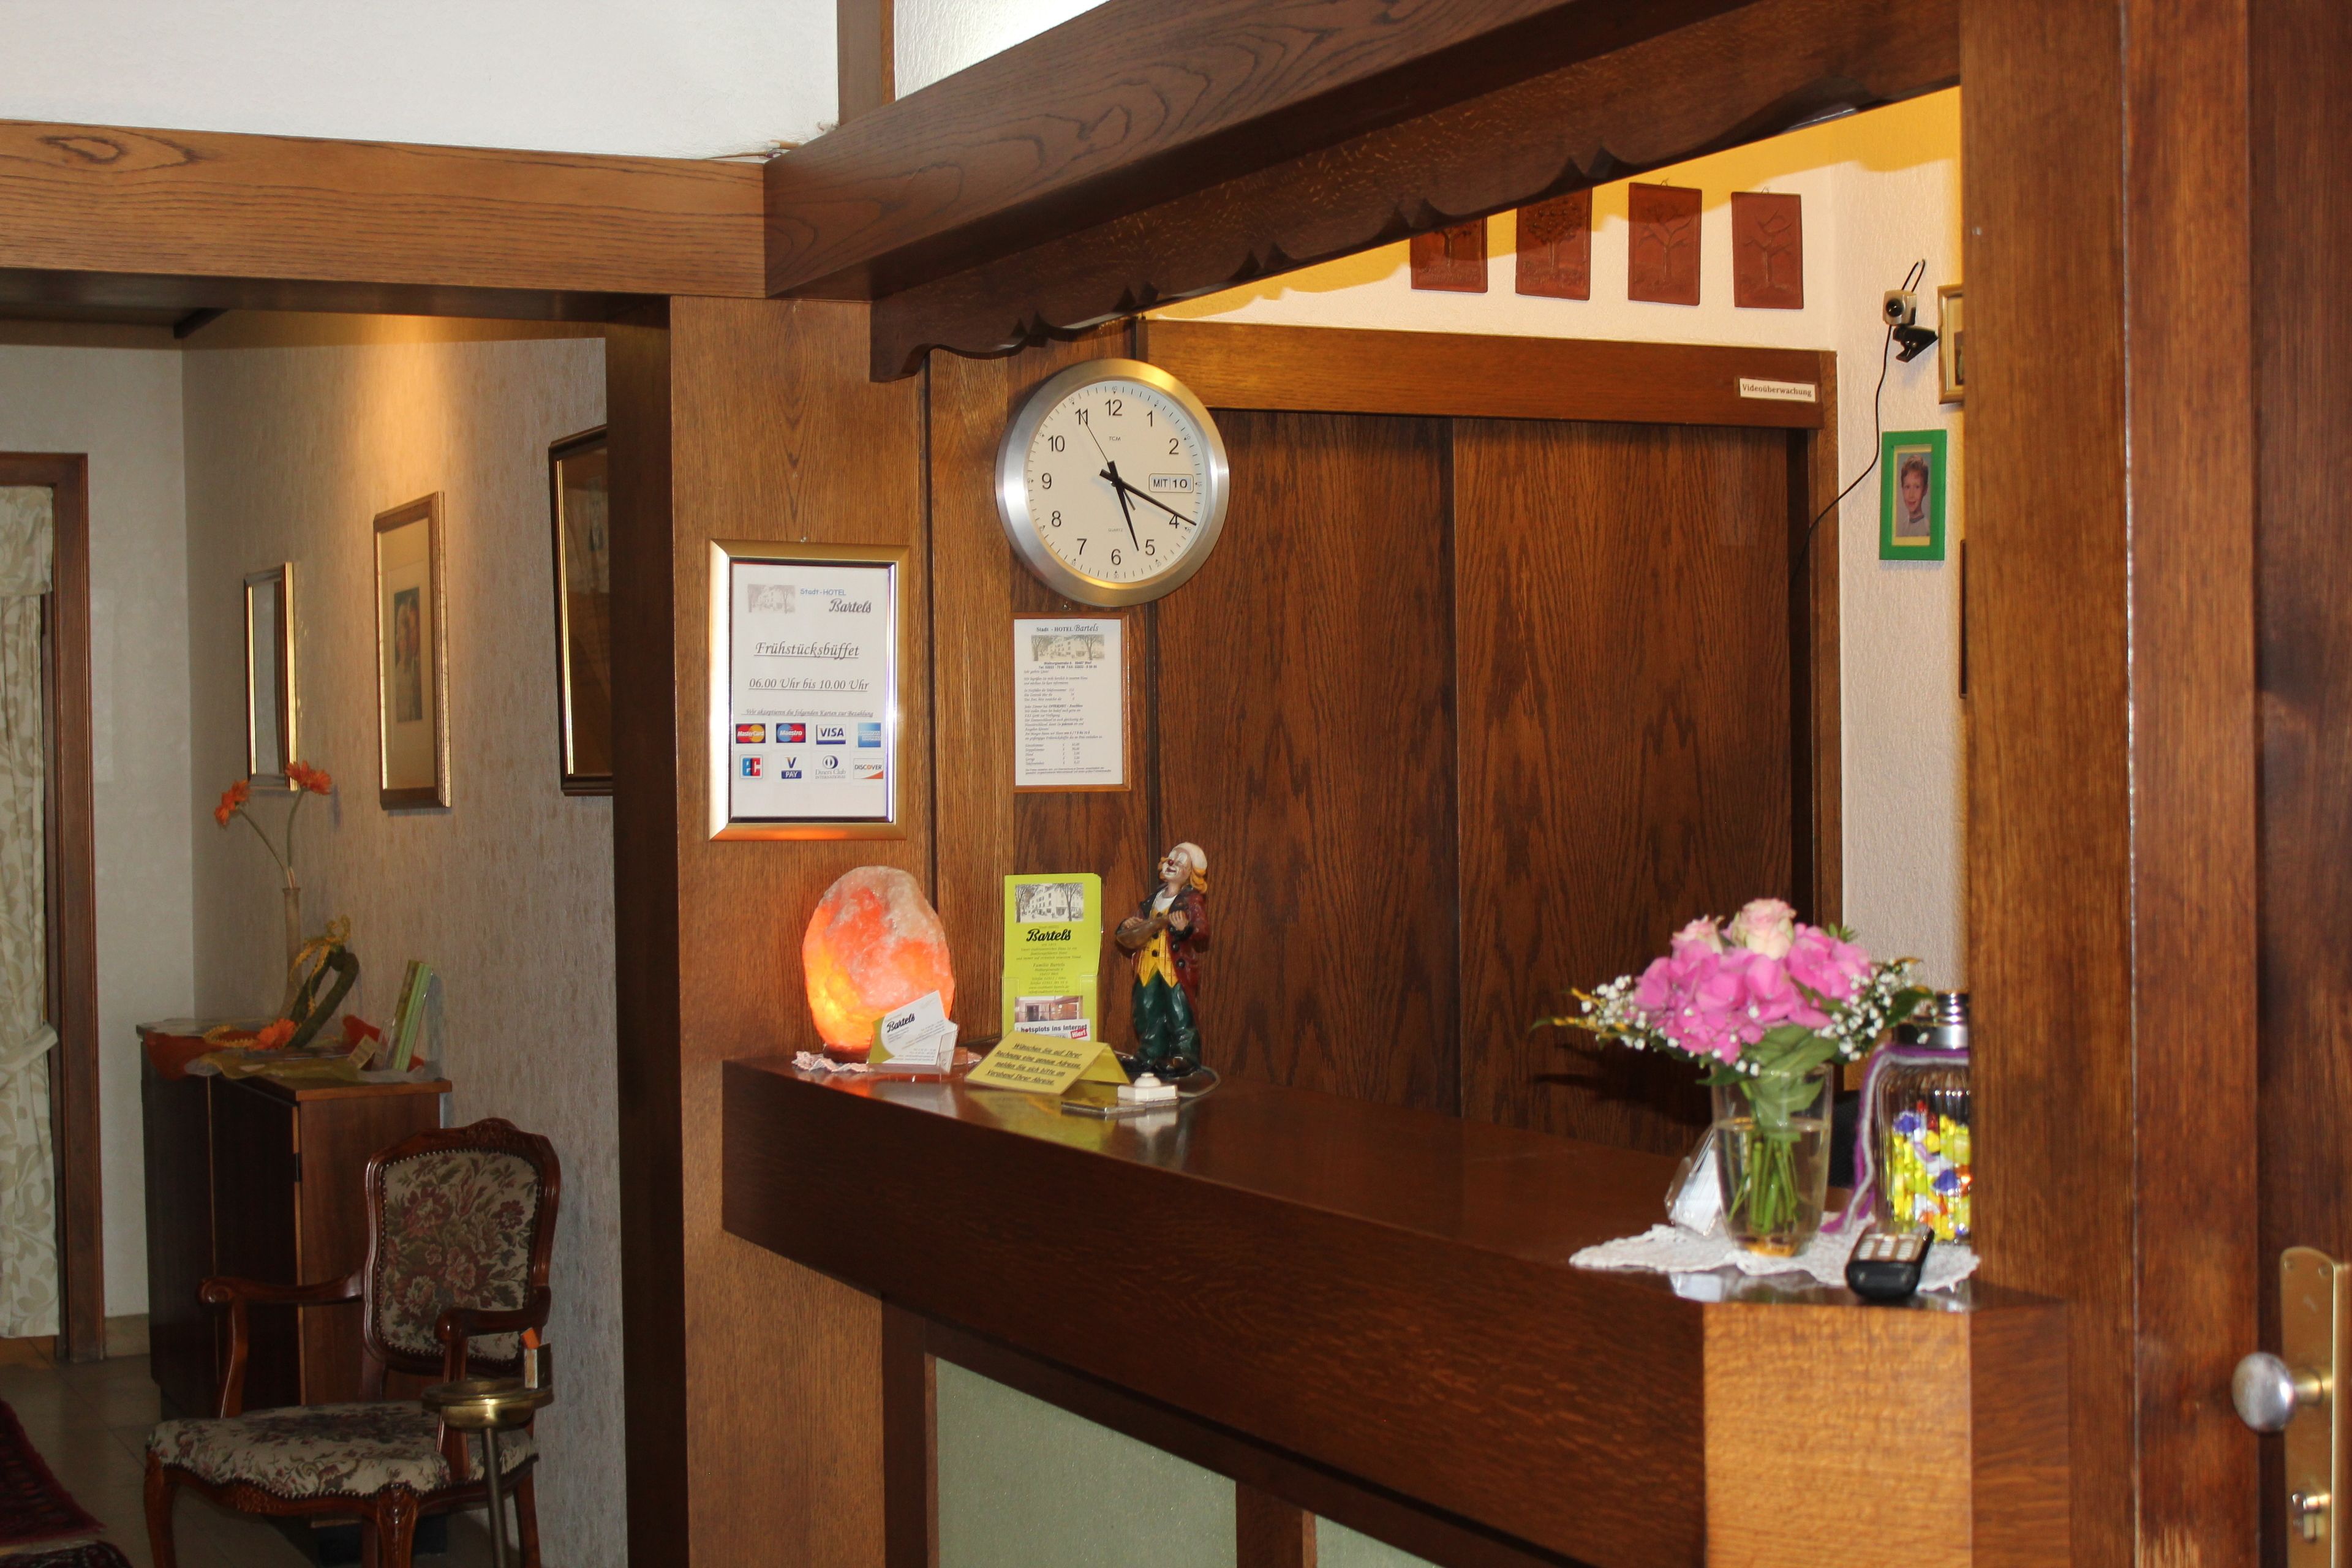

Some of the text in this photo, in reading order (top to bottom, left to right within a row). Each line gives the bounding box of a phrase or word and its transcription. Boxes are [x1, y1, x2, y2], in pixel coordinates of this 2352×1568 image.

[1742, 383, 1812, 398] Videoüberwachung
[1105, 399, 1122, 417] 12
[1075, 409, 1089, 426] 11
[1147, 410, 1153, 427] 1
[1047, 435, 1065, 452] 10
[1169, 438, 1179, 454] 2
[1041, 472, 1052, 489] 9
[1153, 478, 1188, 489] MIT 10
[1051, 510, 1061, 527] 8
[1169, 513, 1180, 529] 4
[1076, 538, 1087, 555] 7
[1145, 539, 1155, 556] 5
[1111, 549, 1121, 565] 6
[829, 598, 872, 613] Bartels
[755, 641, 860, 660] Frühstücksbüffet
[749, 677, 869, 690] 06.00 Uhr bis 10.00 Uhr
[820, 727, 844, 737] VISA
[786, 756, 797, 768] V
[1026, 929, 1071, 942] Bartels
[887, 1012, 915, 1033] Bartels
[1072, 1030, 1086, 1038] Hier!
